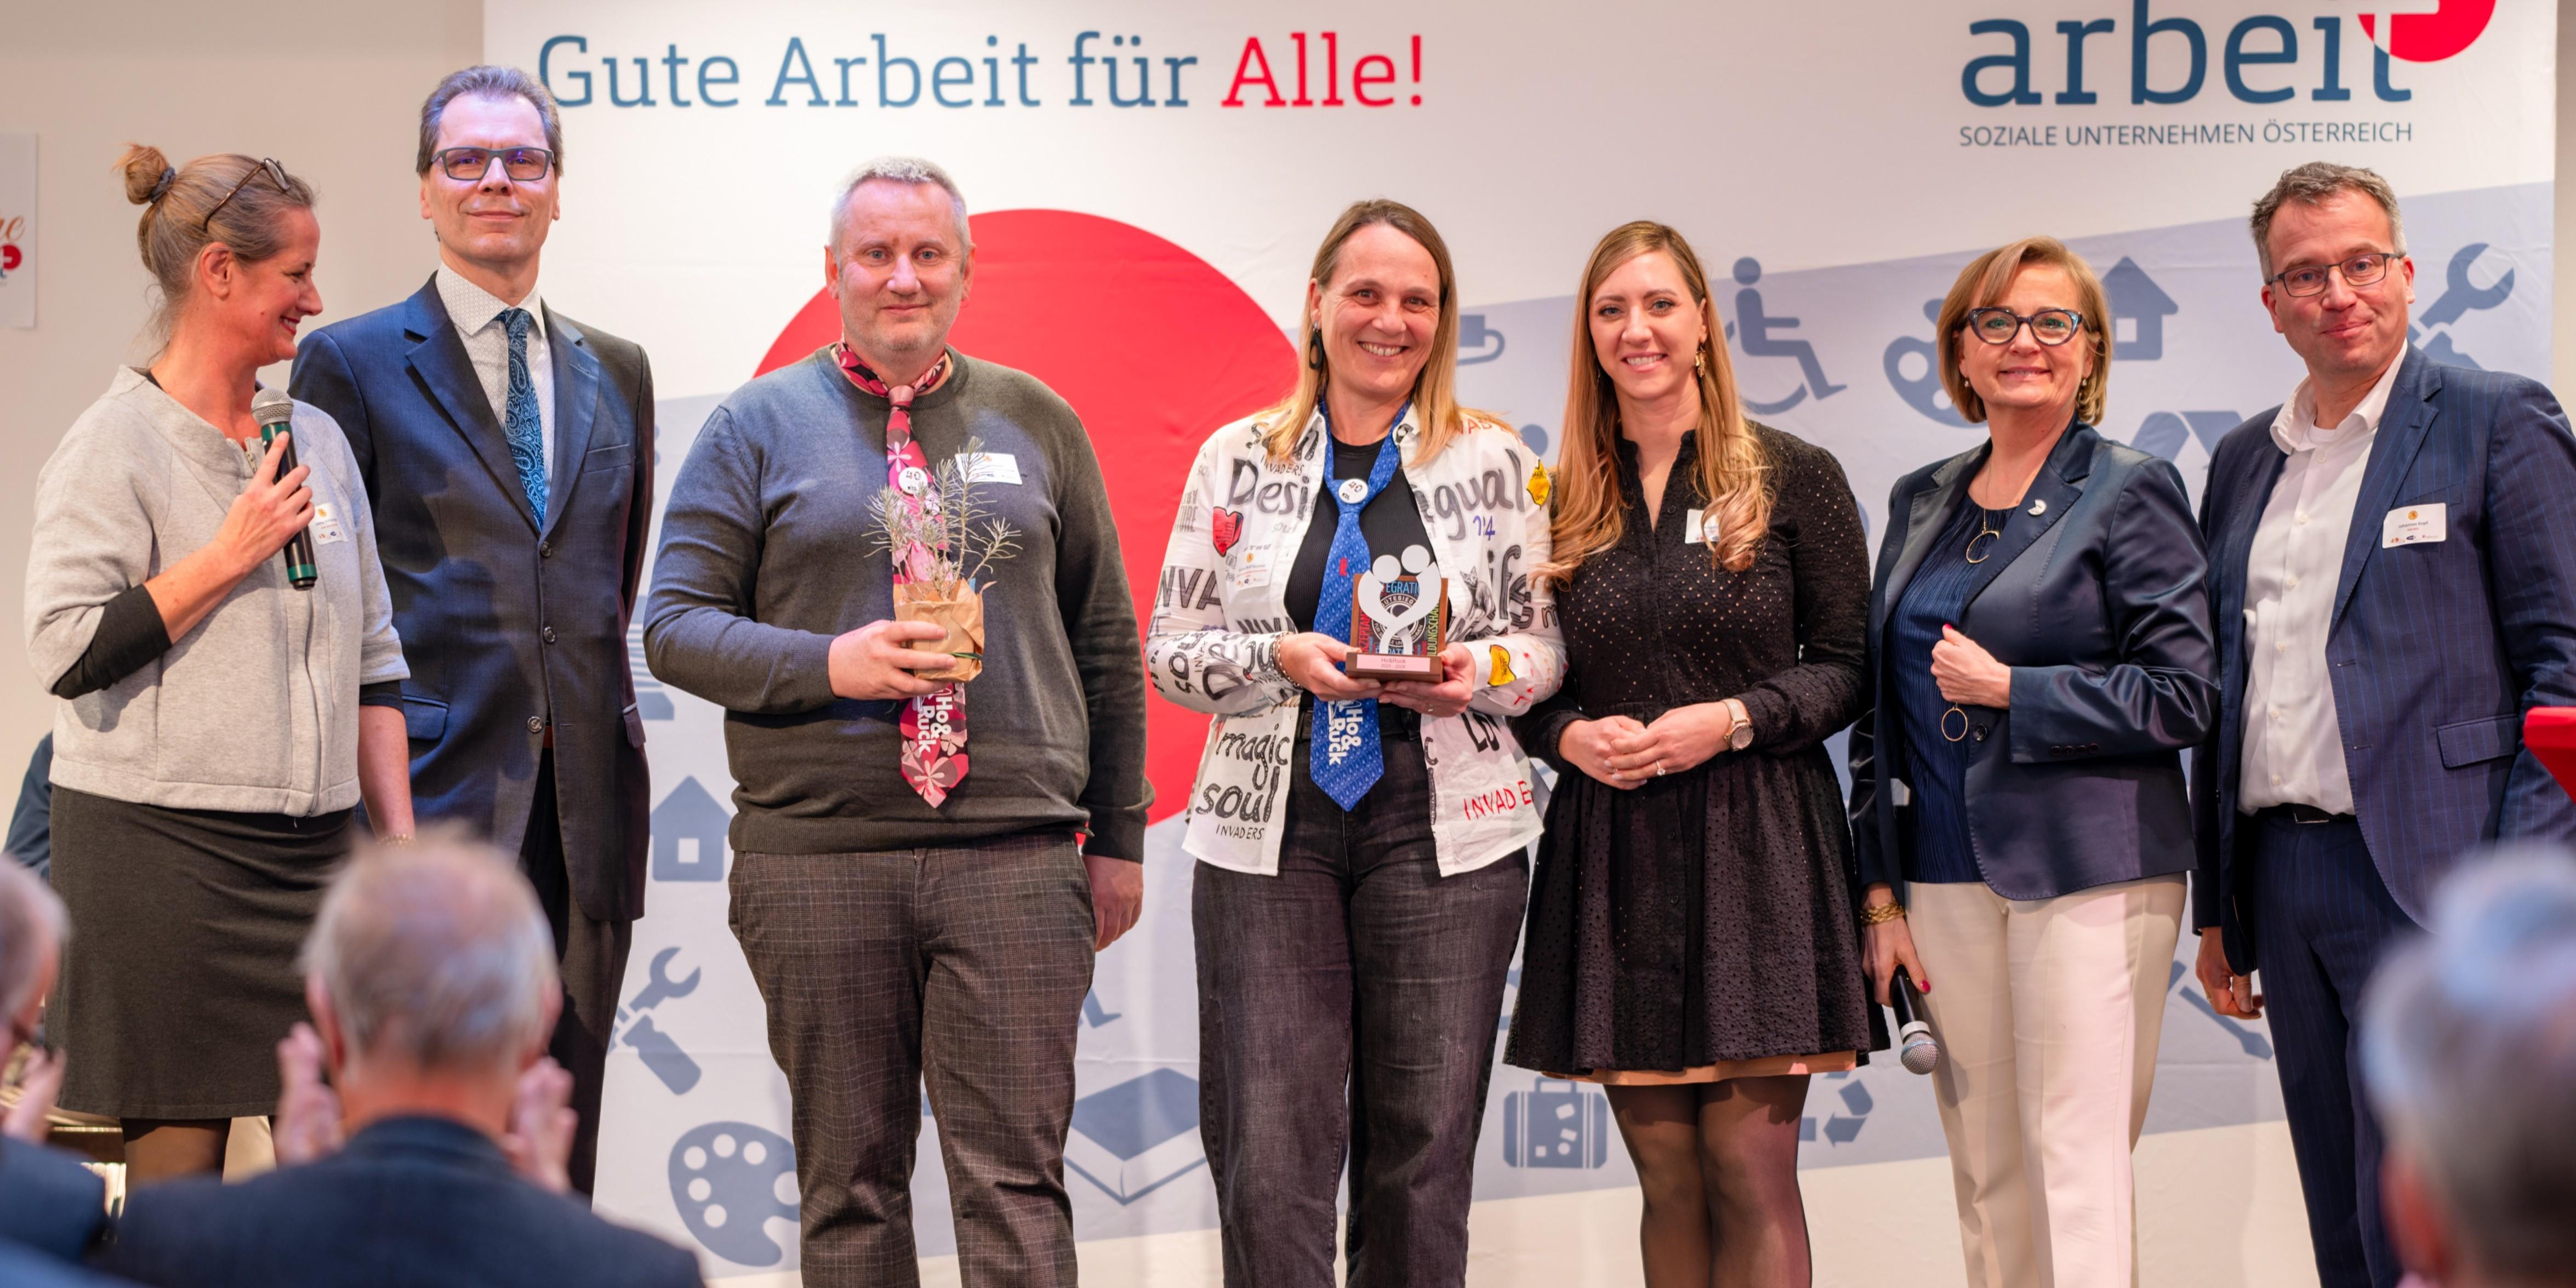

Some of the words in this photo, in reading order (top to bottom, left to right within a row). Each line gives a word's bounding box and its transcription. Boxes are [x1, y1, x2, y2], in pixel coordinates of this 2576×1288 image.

[538, 35, 740, 109] Gute
[765, 32, 1041, 109] Arbeit
[1068, 31, 1198, 109] für
[1221, 31, 1424, 109] Alle!
[1961, 0, 2413, 108] arbeit
[1959, 126, 2058, 147] SOZIALE
[2065, 123, 2254, 146] UNTERNEHMEN
[2262, 117, 2413, 144] ÖSTERREICH
[917, 705, 937, 753] Ruck
[930, 696, 953, 739] Ho&
[1328, 717, 1348, 766] Ruck
[1341, 708, 1364, 752] Ho&
[1215, 723, 1290, 791] magic
[1195, 766, 1280, 823] soul
[1216, 824, 1265, 840] INVADERS
